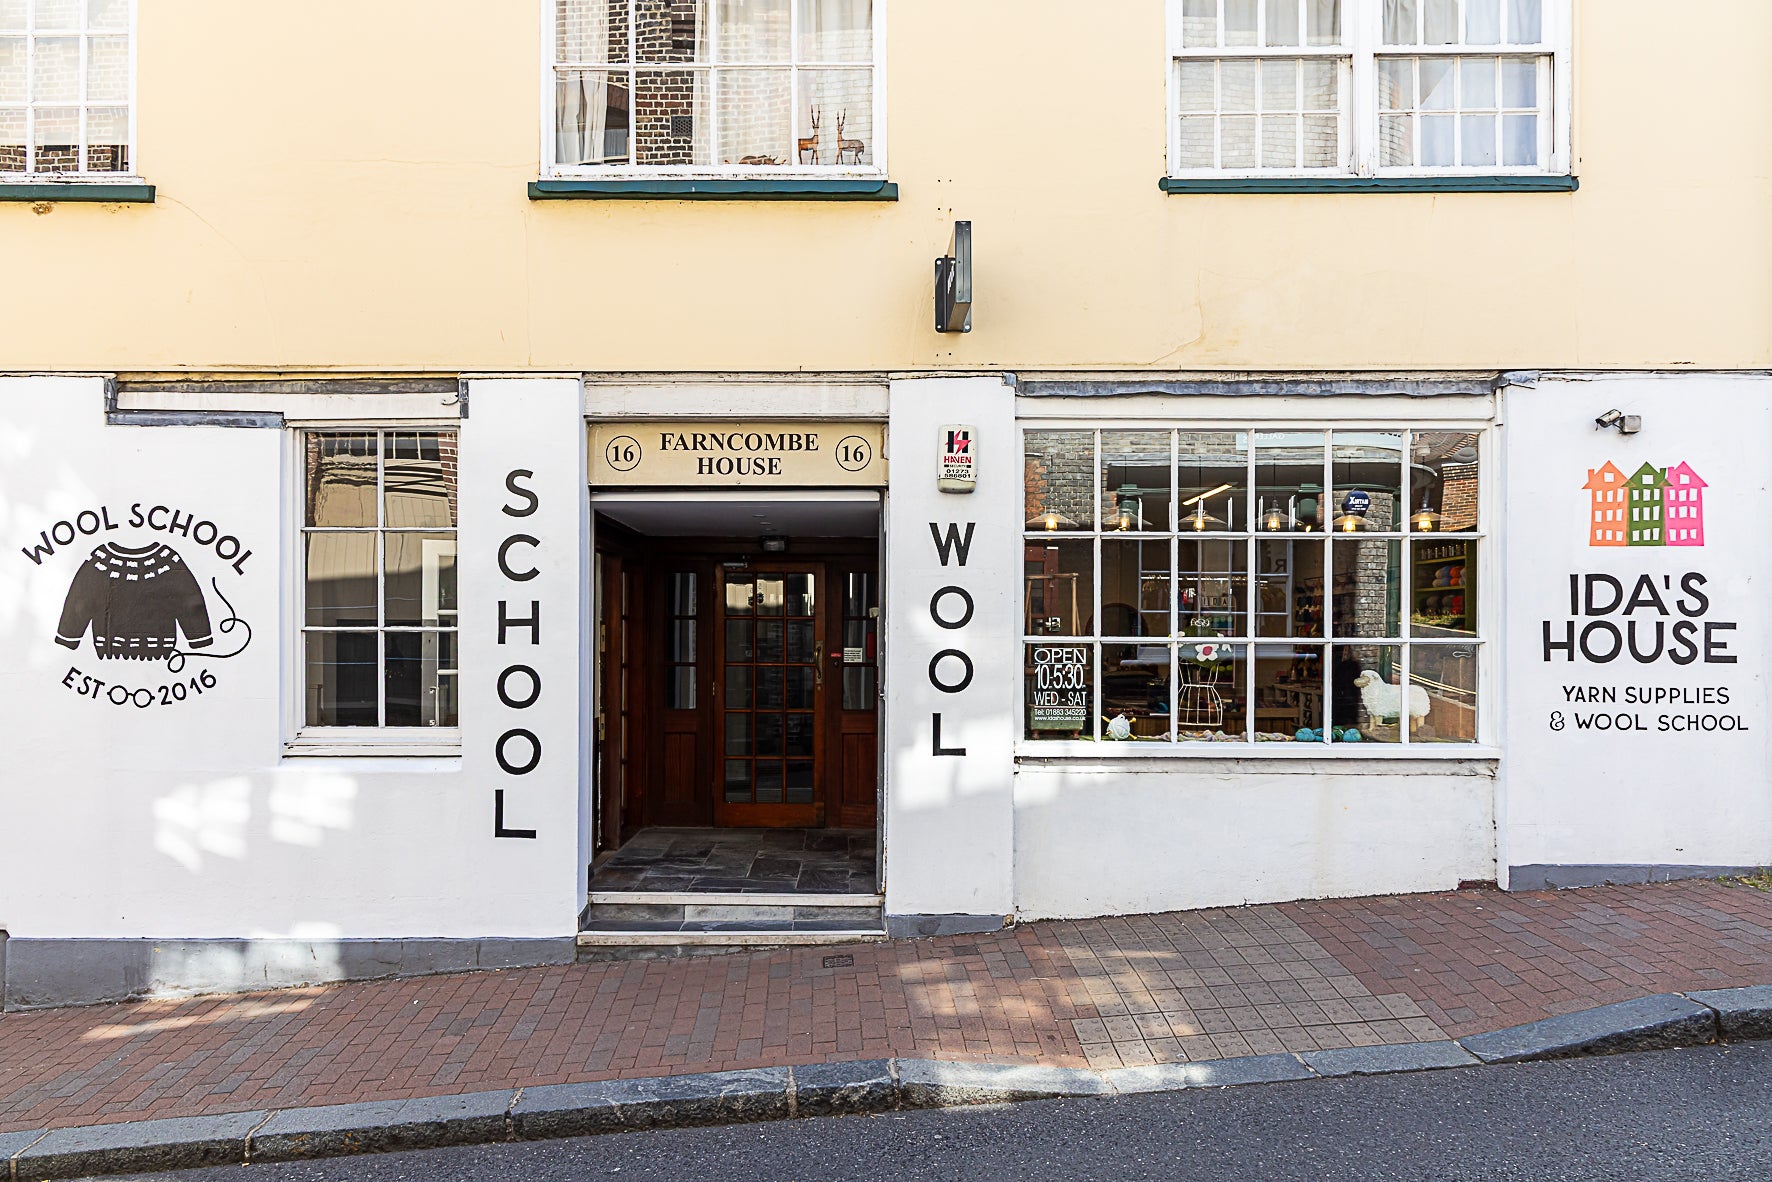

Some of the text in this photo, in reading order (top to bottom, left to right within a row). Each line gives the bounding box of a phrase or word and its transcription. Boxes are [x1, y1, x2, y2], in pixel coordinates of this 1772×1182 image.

[660, 433, 819, 451] FARNCOMBE
[613, 445, 634, 462] 16
[843, 445, 864, 462] 16
[697, 457, 782, 475] HOUSE
[22, 503, 253, 576] WOOL SCHOOL
[1570, 572, 1709, 617] IDA'S
[929, 522, 976, 756] WOOL
[1543, 620, 1738, 666] HOUSE
[495, 469, 541, 839] SCHOOL
[1034, 648, 1087, 664] OPEN
[62, 666, 217, 706] EST 2016
[1563, 685, 1730, 704] YARN SUPPLIES
[1034, 691, 1059, 706] WED
[1068, 691, 1087, 706] SAT
[1065, 708, 1087, 716] 345220
[1549, 711, 1749, 732] & WOOL SCHOOL
